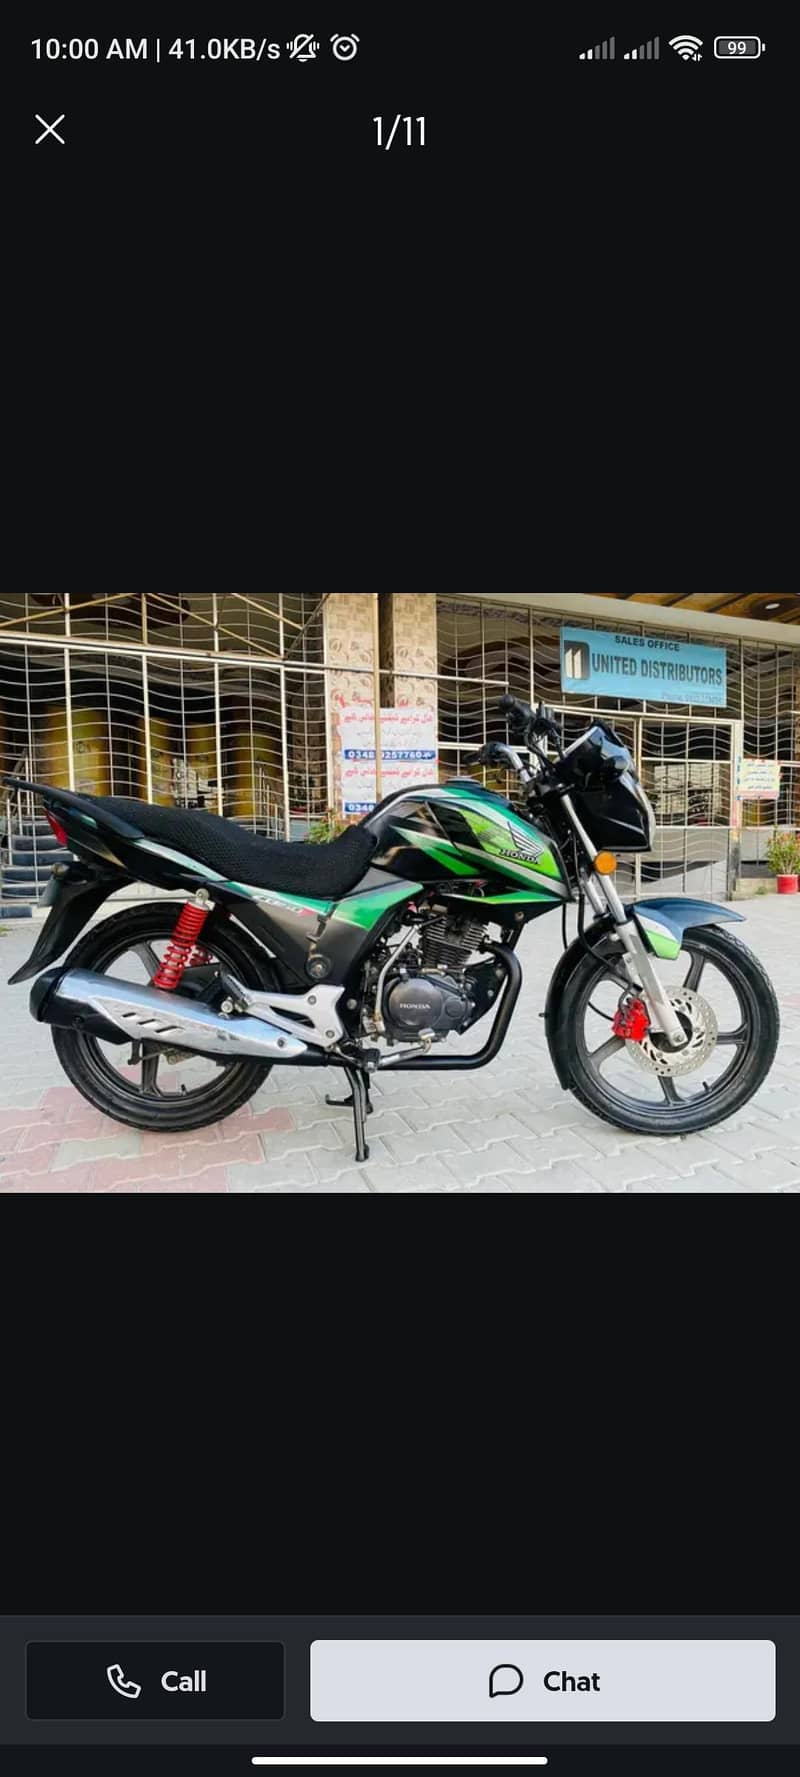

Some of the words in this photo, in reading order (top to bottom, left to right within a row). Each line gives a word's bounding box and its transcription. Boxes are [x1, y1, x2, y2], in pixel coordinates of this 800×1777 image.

[31, 38, 99, 60] 10:00
[105, 38, 148, 60] AM
[168, 38, 281, 61] 41.0KB/s
[727, 42, 747, 55] 99
[372, 114, 425, 150] 1/11
[614, 635, 645, 648] SALES
[647, 639, 680, 652] OFFICE
[591, 653, 638, 677] UNITED
[640, 659, 723, 687] DISTRIBUTORS
[500, 848, 539, 865] HONDA
[399, 1002, 431, 1010] HONDA
[160, 1669, 207, 1692] Call
[543, 1670, 601, 1692] Chat
